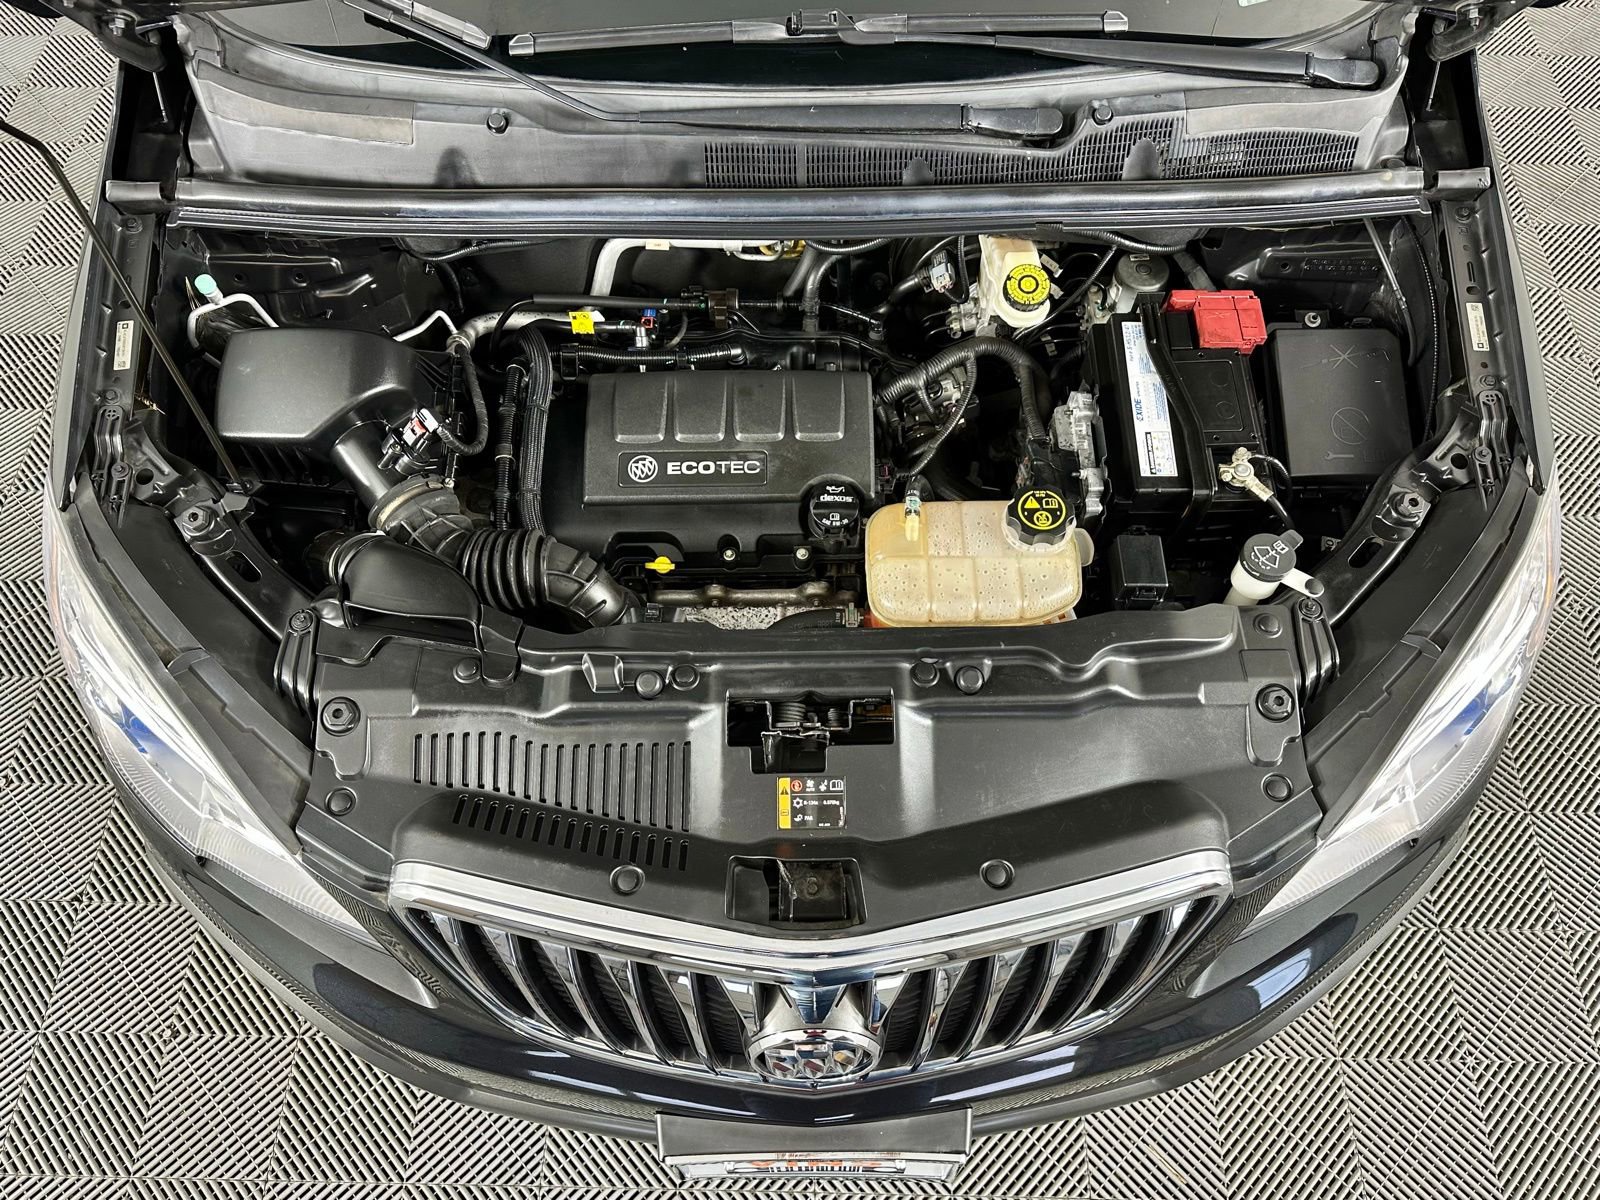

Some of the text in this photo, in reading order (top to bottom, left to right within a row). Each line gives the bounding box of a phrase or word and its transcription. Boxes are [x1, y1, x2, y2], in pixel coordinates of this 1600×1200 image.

[1135, 398, 1144, 422] EXIDE
[666, 460, 761, 475] ECOTEC
[819, 493, 854, 503] dexos
